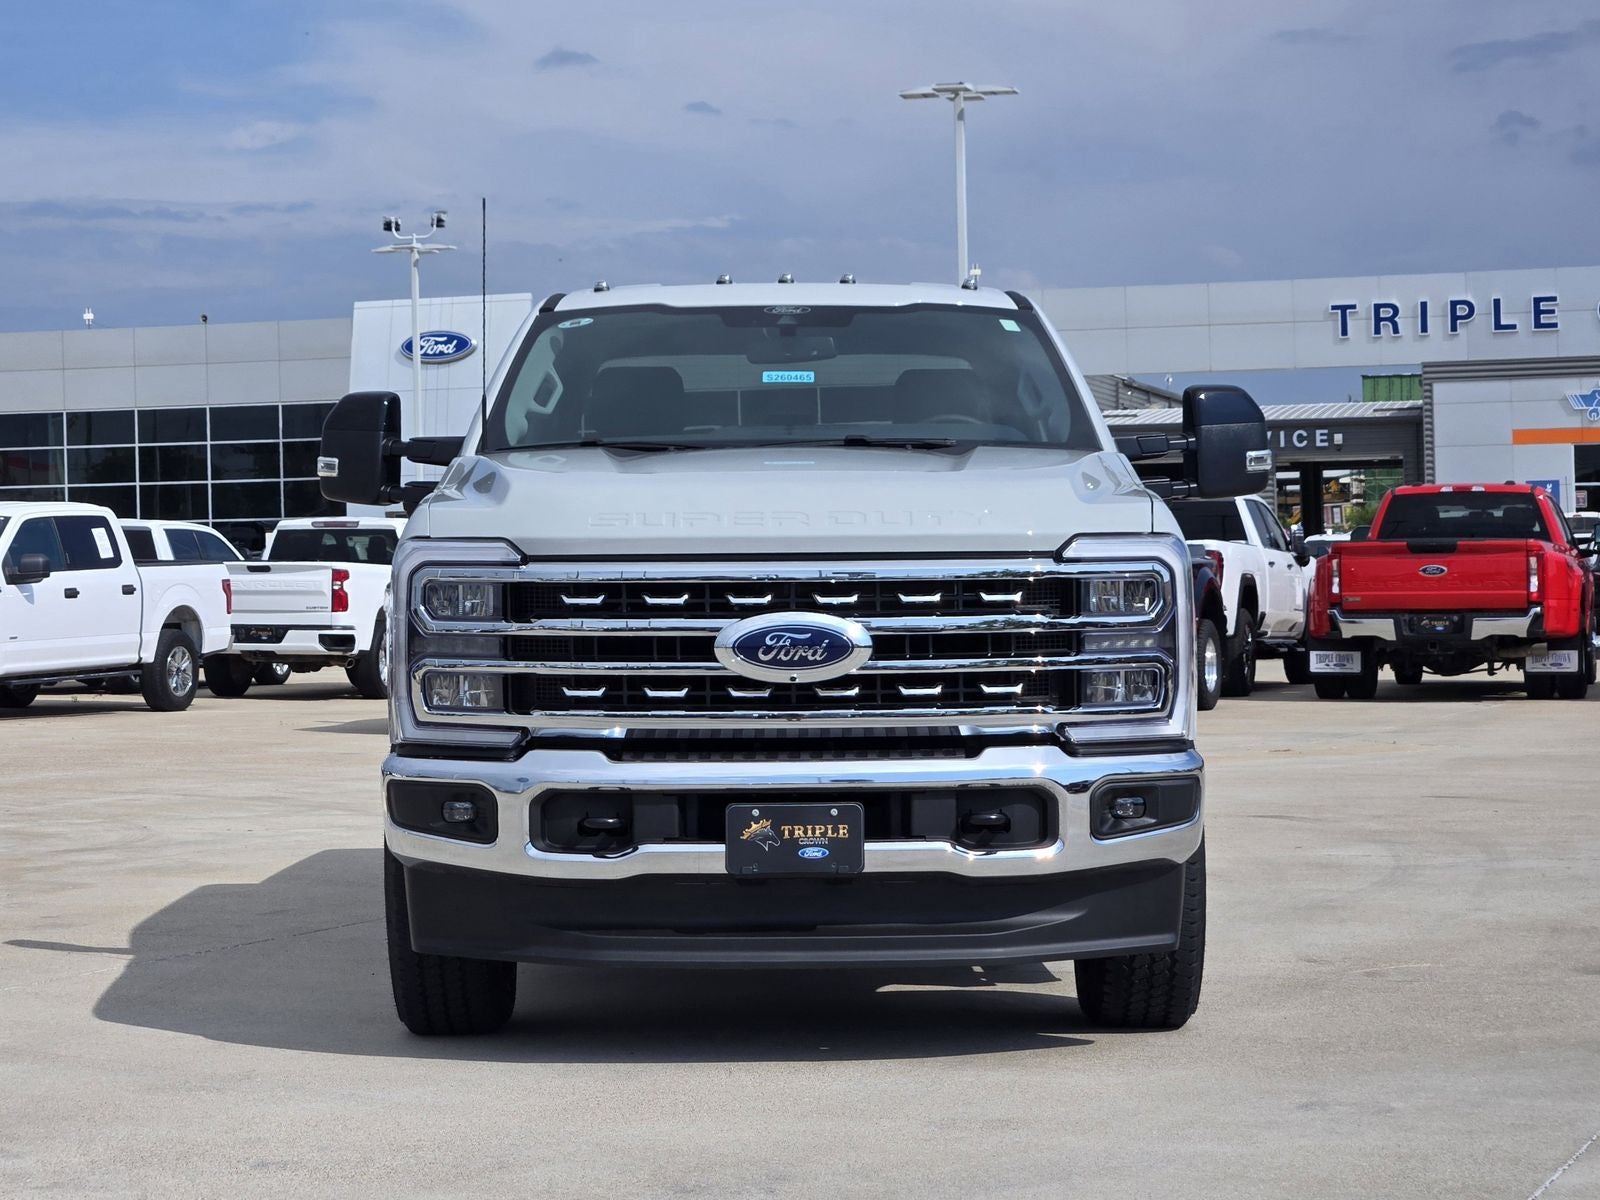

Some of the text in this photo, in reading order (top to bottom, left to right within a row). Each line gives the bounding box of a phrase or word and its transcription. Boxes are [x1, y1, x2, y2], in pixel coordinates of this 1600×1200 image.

[1329, 295, 1560, 339] TRIPLE
[418, 336, 458, 355] Ford
[765, 373, 812, 382] S260465
[1266, 429, 1329, 448] ICE
[588, 508, 994, 529] SUPER DUTY
[757, 631, 829, 662] Ford
[781, 824, 849, 839] TRIPLE
[798, 837, 828, 845] CROWN
